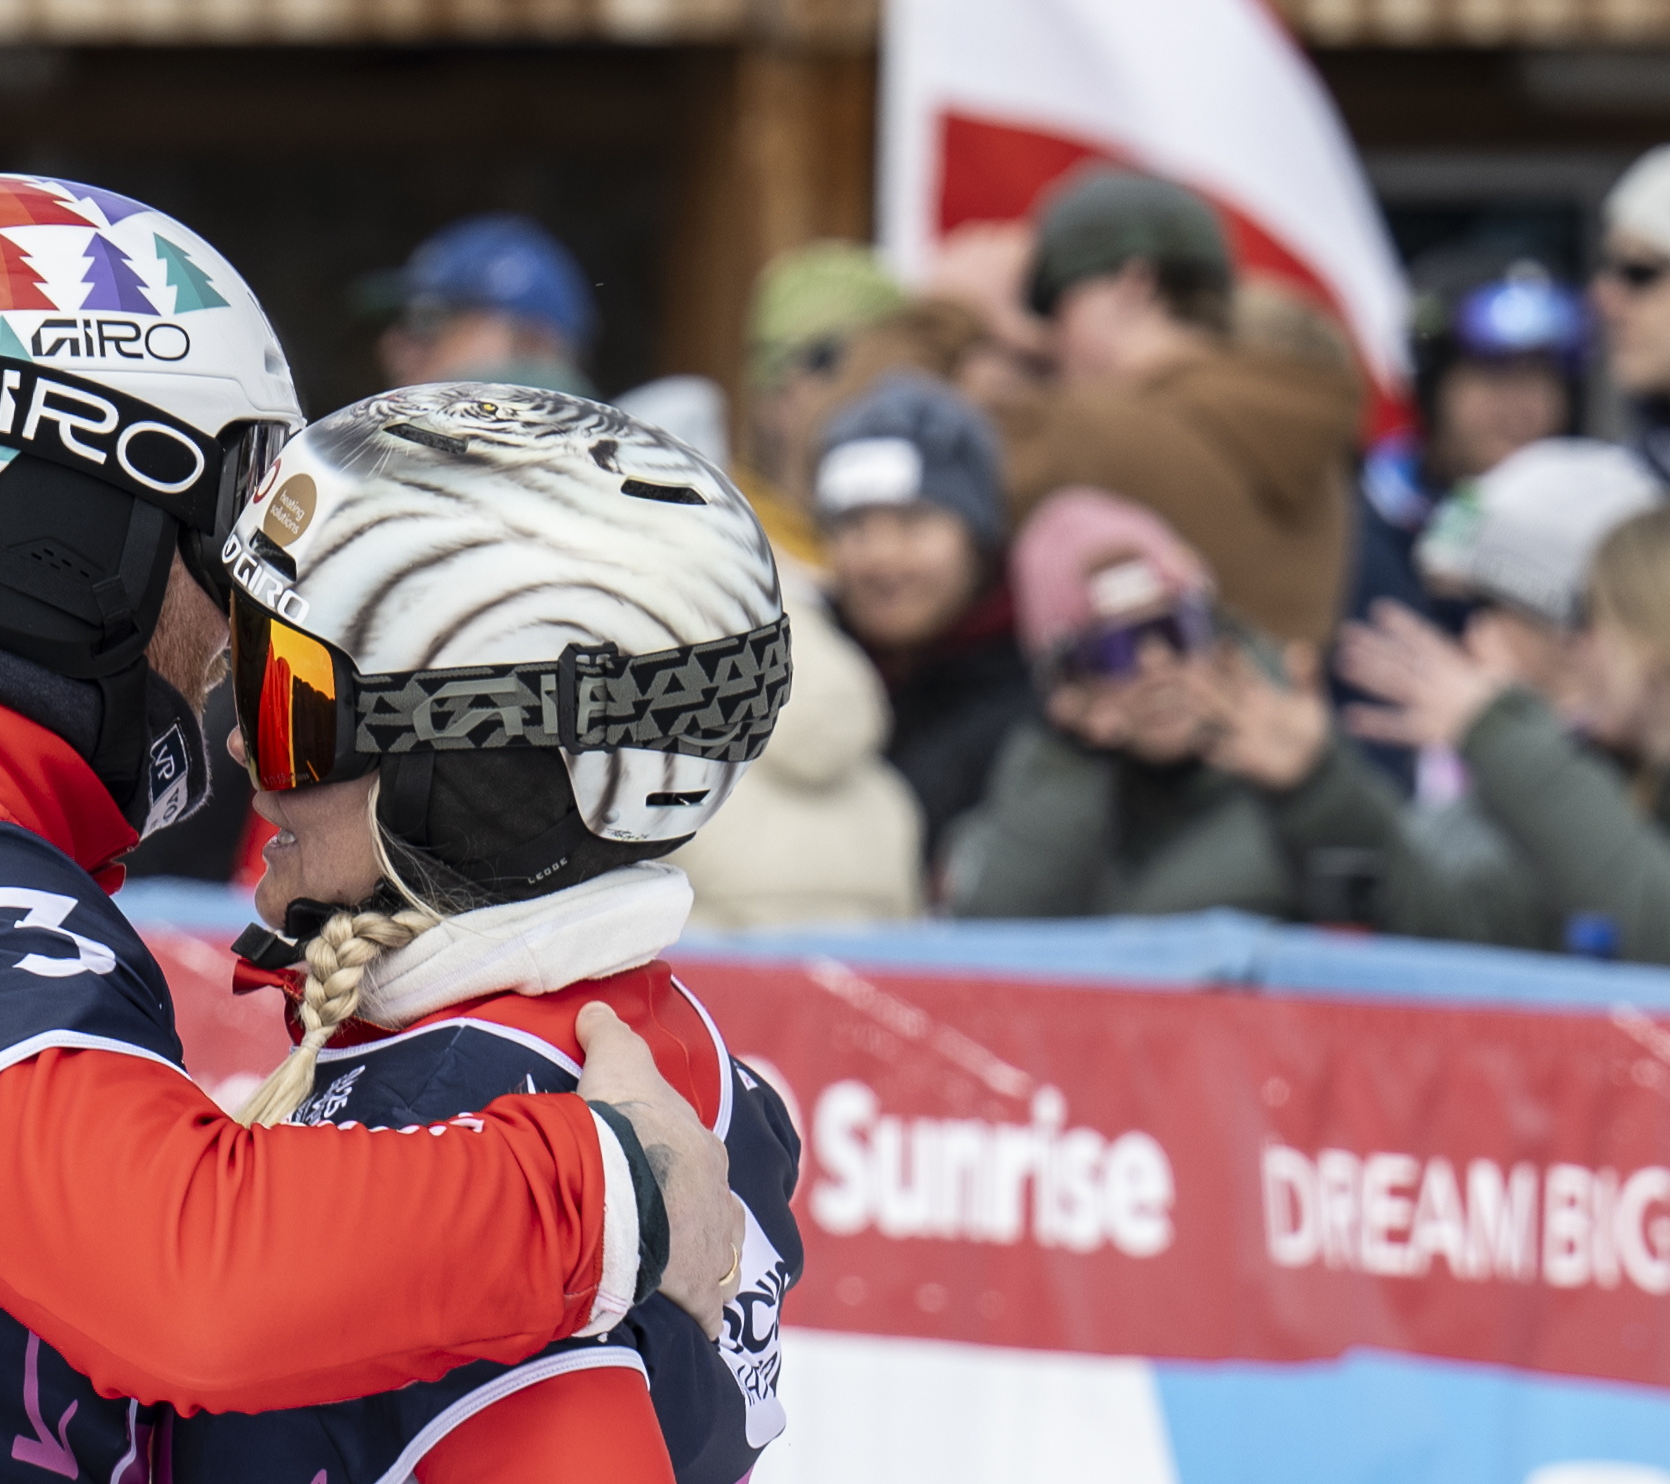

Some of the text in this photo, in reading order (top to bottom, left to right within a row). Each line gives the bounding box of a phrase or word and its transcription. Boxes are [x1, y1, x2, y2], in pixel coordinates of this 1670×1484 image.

[31, 319, 191, 361] GIRO
[269, 504, 301, 535] solutions
[279, 490, 305, 521] heating
[233, 551, 311, 627] GIRO
[810, 1080, 1176, 1258] Sunrise
[1261, 1141, 1539, 1286] DREAM
